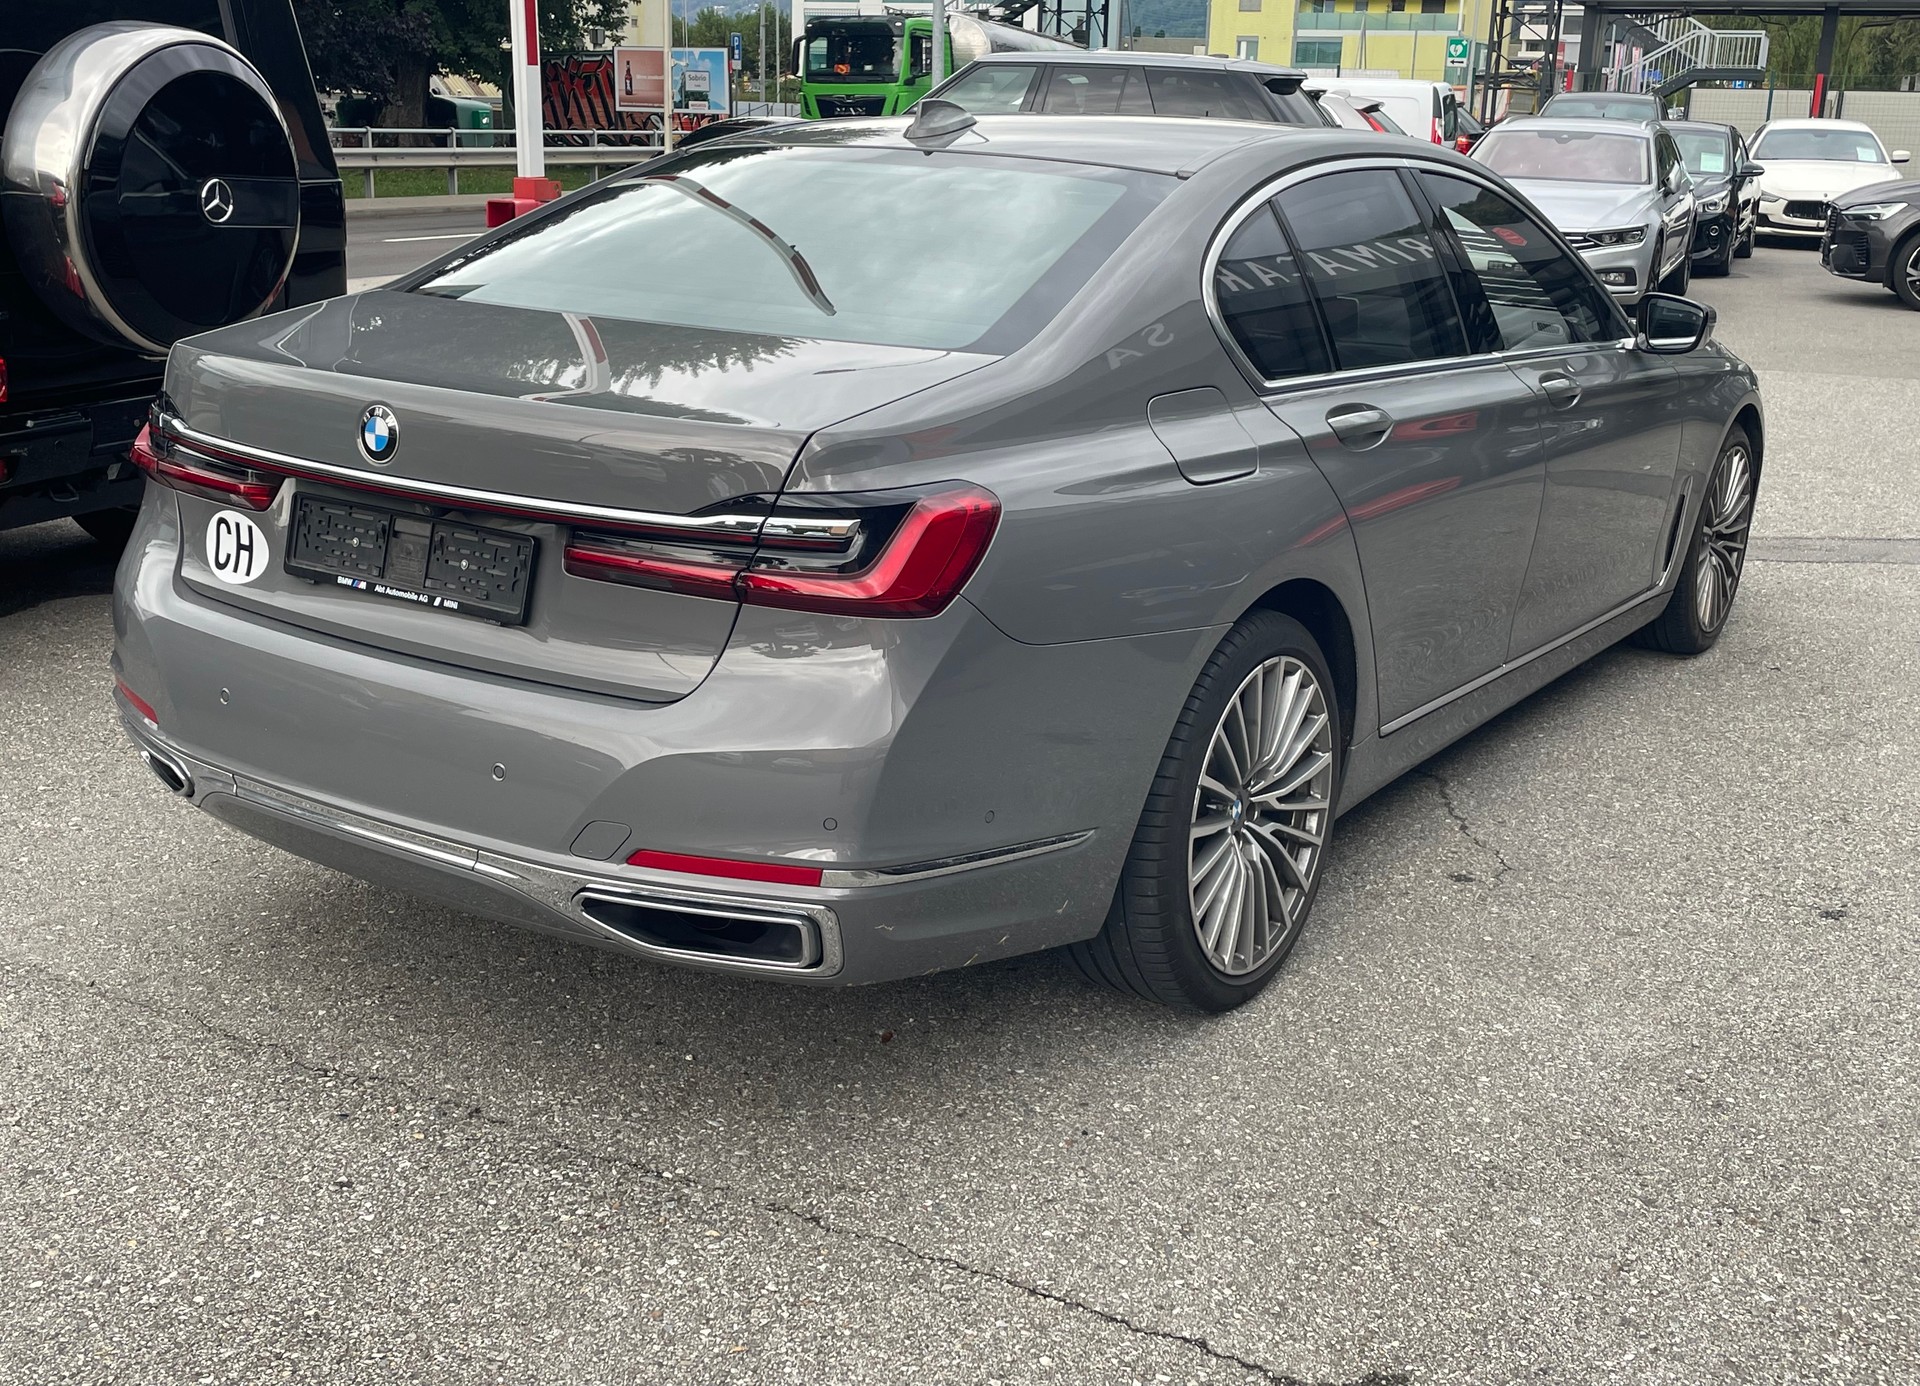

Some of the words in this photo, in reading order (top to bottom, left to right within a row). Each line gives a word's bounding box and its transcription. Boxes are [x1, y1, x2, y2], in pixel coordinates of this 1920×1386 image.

[733, 36, 740, 50] P
[363, 407, 396, 427] BMW
[214, 516, 254, 577] CH
[337, 575, 353, 586] BMW
[374, 584, 385, 594] Abt
[385, 586, 418, 601] Automobile
[418, 594, 429, 603] AG
[443, 599, 459, 610] MINI
